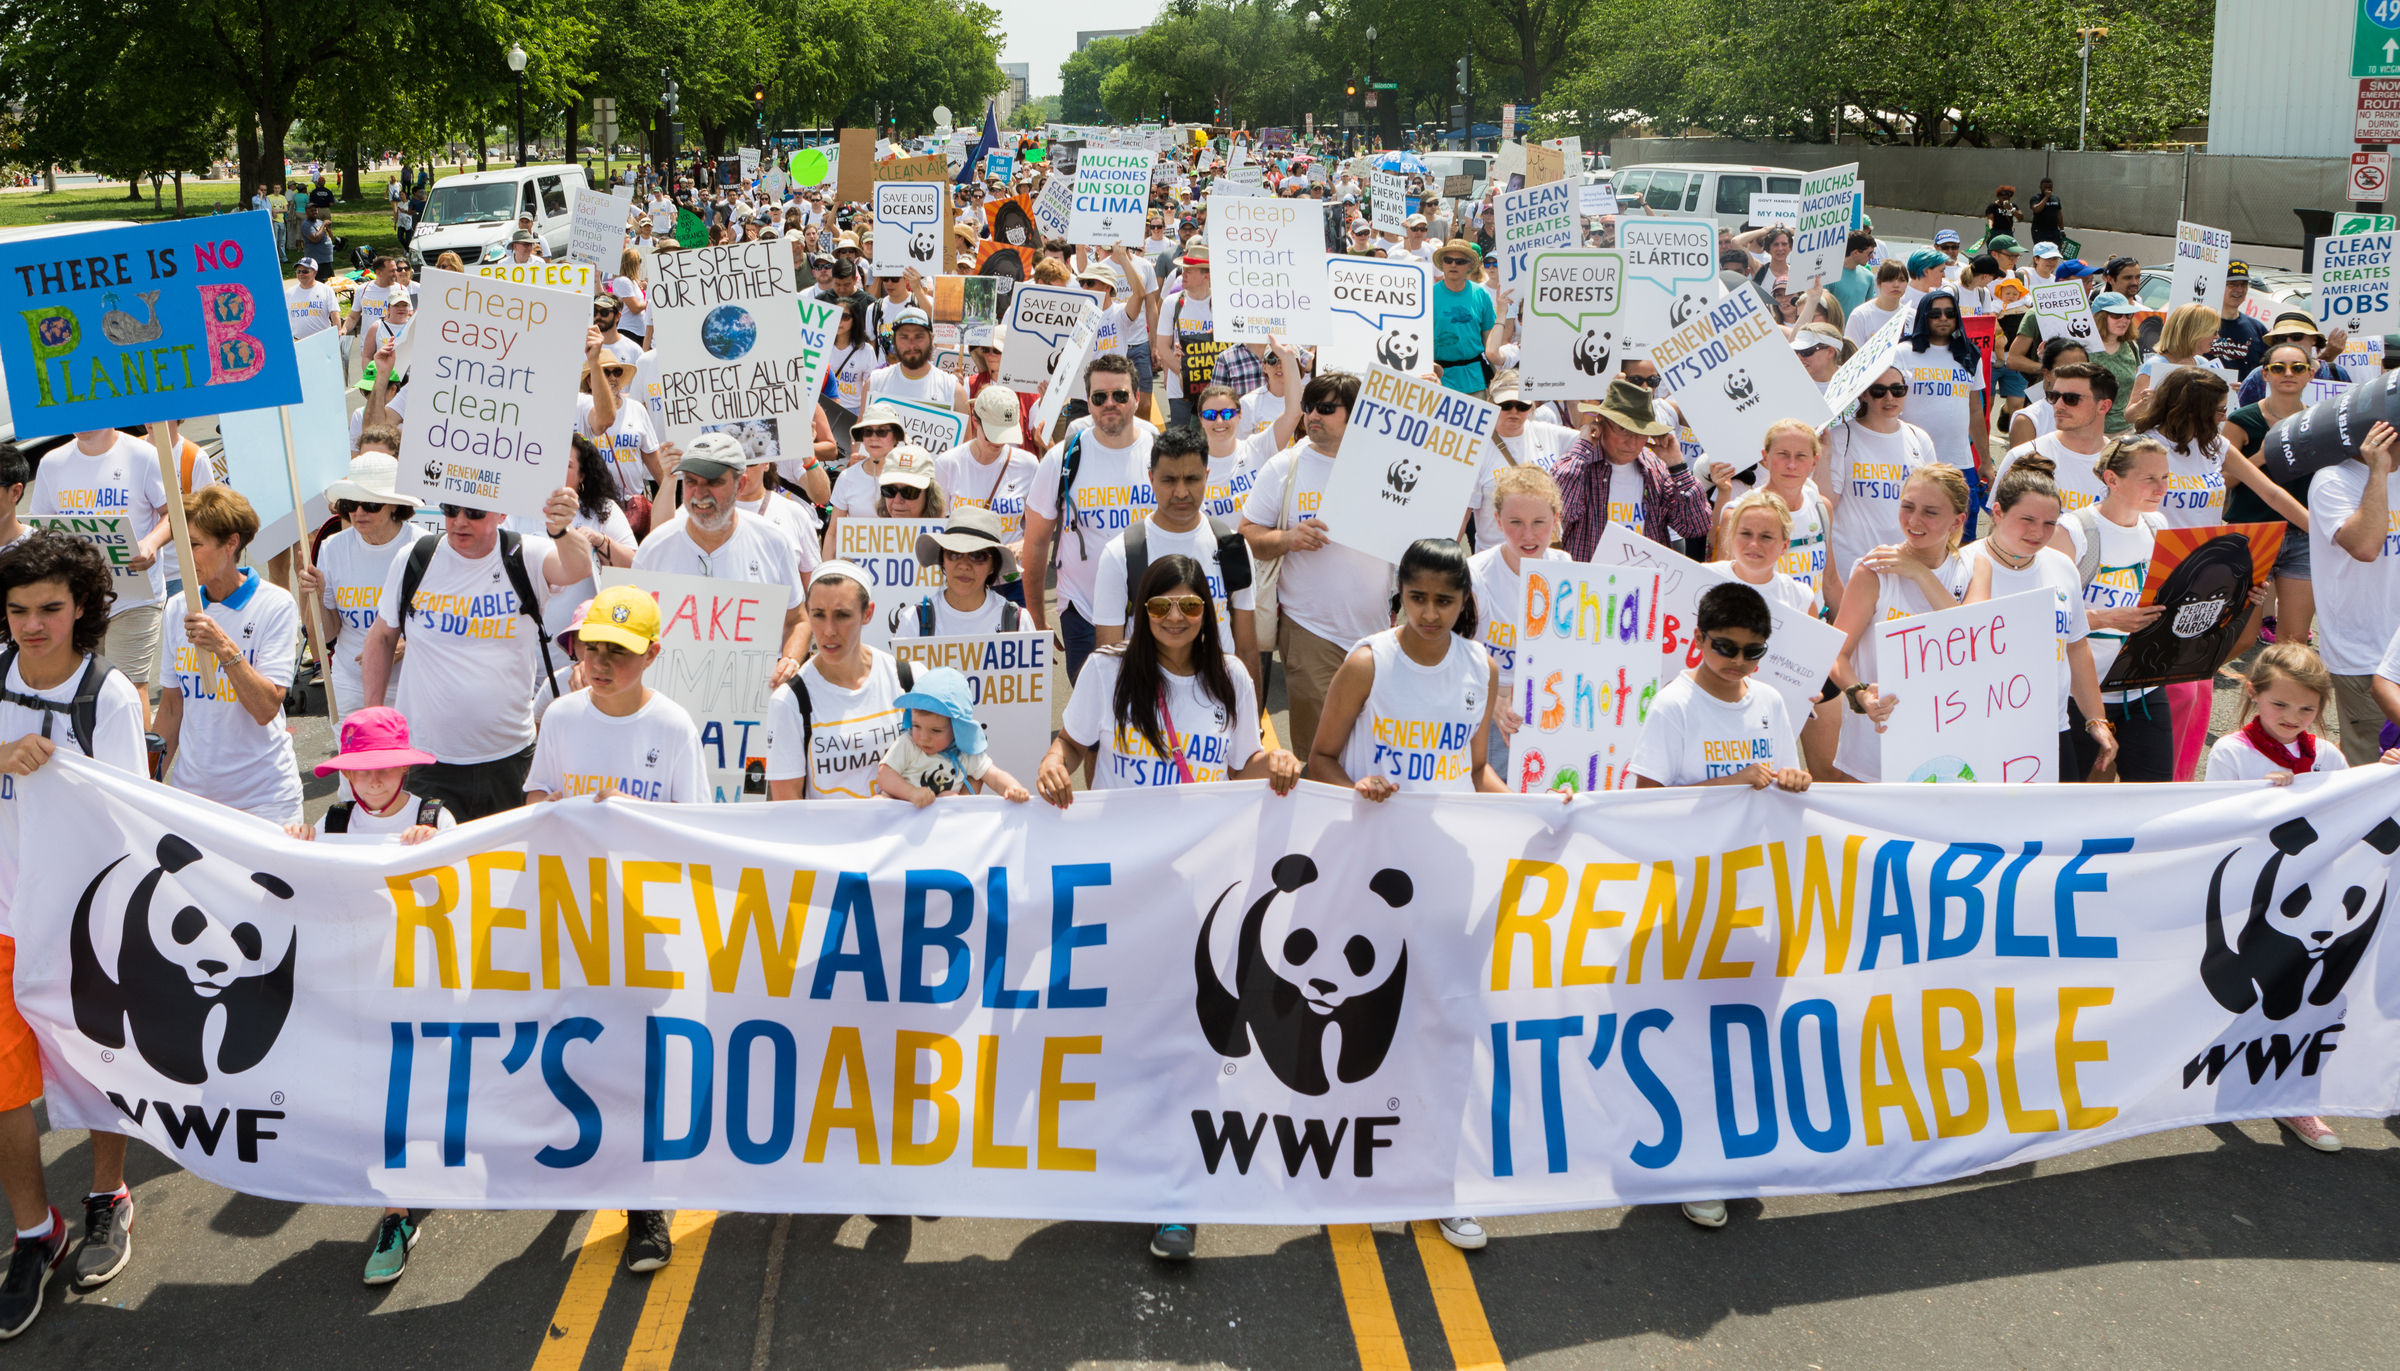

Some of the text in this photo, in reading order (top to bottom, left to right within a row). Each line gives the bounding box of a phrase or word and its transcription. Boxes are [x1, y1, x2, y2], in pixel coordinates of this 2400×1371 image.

[2368, 65, 2377, 74] TO
[2359, 111, 2371, 119] NO
[2368, 120, 2398, 128] DURING
[1081, 155, 1148, 169] MUCHAS
[2355, 155, 2366, 163] NO
[879, 160, 948, 181] CLEAN AIR
[1080, 170, 1147, 182] NACIONES
[1373, 172, 1401, 188] CLEAN
[1078, 182, 1146, 196] UN SOLO
[1372, 185, 1406, 202] ENERGY
[1804, 172, 1854, 197] MUCHAS
[579, 191, 610, 208] barata
[882, 193, 934, 203] SAVE OUR
[1076, 196, 1143, 214] CLIMA
[1373, 199, 1404, 215] MEANS
[1504, 184, 1568, 212] CLEAN
[1802, 190, 1852, 214] NACIONES
[577, 203, 596, 216] fácil
[882, 204, 934, 215] OCEANS
[1034, 205, 1068, 235] JOBS
[1224, 200, 1296, 228] cheap
[1378, 212, 1400, 226] JOBS
[1506, 200, 1570, 226] ENERGY
[1800, 206, 1850, 232] UN SOLO
[574, 226, 602, 242] limpia
[575, 214, 624, 236] inteligente
[1506, 215, 1571, 241] CREATES
[2379, 217, 2391, 230] 2
[572, 238, 607, 255] posible
[1225, 226, 1278, 248] easy
[1507, 231, 1571, 254] AMERICAN
[1626, 232, 1708, 248] SALVEMOS
[1796, 225, 1846, 254] CLIMA
[2180, 225, 2229, 250] RENOVABLE ES
[2325, 236, 2392, 254] CLEAN
[657, 242, 777, 282] RESPECT
[1226, 248, 1296, 267] smart
[1630, 248, 1710, 267] EL ÁRTICO
[2178, 241, 2218, 264] SALUDABLE
[2324, 252, 2392, 268] ENERGY
[15, 239, 244, 297] THERE IS NO
[1228, 266, 1290, 288] clean
[1541, 267, 1616, 282] SAVE OUR
[2322, 266, 2391, 283] CREATES
[652, 267, 792, 308] OUR MOTHER
[1334, 270, 1417, 290] SAVE OUR
[2322, 282, 2390, 296] AMERICAN
[1024, 298, 1056, 311] SAVE
[1230, 288, 1311, 310] doable
[1334, 285, 1416, 306] OCEANS
[1539, 286, 1614, 302] FORESTS
[2036, 288, 2078, 300] SAVE OUR
[2039, 298, 2082, 310] FORESTS
[290, 301, 323, 310] RENEWABLE
[444, 280, 548, 330] cheap
[2320, 293, 2390, 322] JOBS
[1248, 316, 1286, 326] RENEWABLE
[1262, 326, 1288, 335] DOABLE
[1650, 290, 1758, 370] RENEWABLE
[19, 283, 266, 408] PLANET B
[441, 320, 518, 360] easy
[1664, 312, 1772, 392] IT'S DOABLE
[435, 354, 536, 394] smart
[662, 356, 804, 399] PROTECT ALL OF
[1190, 370, 1200, 382] IS
[1914, 382, 1934, 396] IT'S
[2310, 382, 2347, 402] THE
[432, 384, 520, 427] clean
[664, 384, 800, 427] HER CHILDREN
[1364, 369, 1492, 436] RENEWABLE
[1736, 394, 1760, 413] WWF
[2338, 394, 2352, 447] AFTER YOU
[428, 418, 544, 466] doable
[1354, 398, 1482, 467] IT'S DOABLE
[2280, 424, 2296, 466] YOU ARE
[422, 480, 440, 488] WWF
[446, 464, 502, 485] RENEWABLE
[58, 488, 129, 508] RENEWABLE
[444, 478, 500, 498] IT'S DOABLE
[1381, 489, 1412, 506] WWF
[1853, 481, 1880, 498] IT'S
[1078, 509, 1106, 530] IT'S
[1524, 571, 1661, 645] Denial
[2178, 611, 2216, 624] CLIMATE
[2183, 601, 2221, 616] PEOPLES
[440, 612, 516, 639] DOABLE
[2174, 620, 2212, 635] MARCH
[1886, 615, 2006, 680] There
[1934, 674, 2032, 733] IS NO
[815, 722, 905, 754] SAVE THE
[1490, 835, 2135, 992] RENEWABLE
[384, 850, 1112, 1010] RENEWABLE
[2183, 1022, 2346, 1090] WWF
[1491, 986, 2120, 1178] IT'S DOABLE
[384, 1015, 1102, 1173] IT'S DOABLE
[1191, 1110, 1401, 1179] WWF
